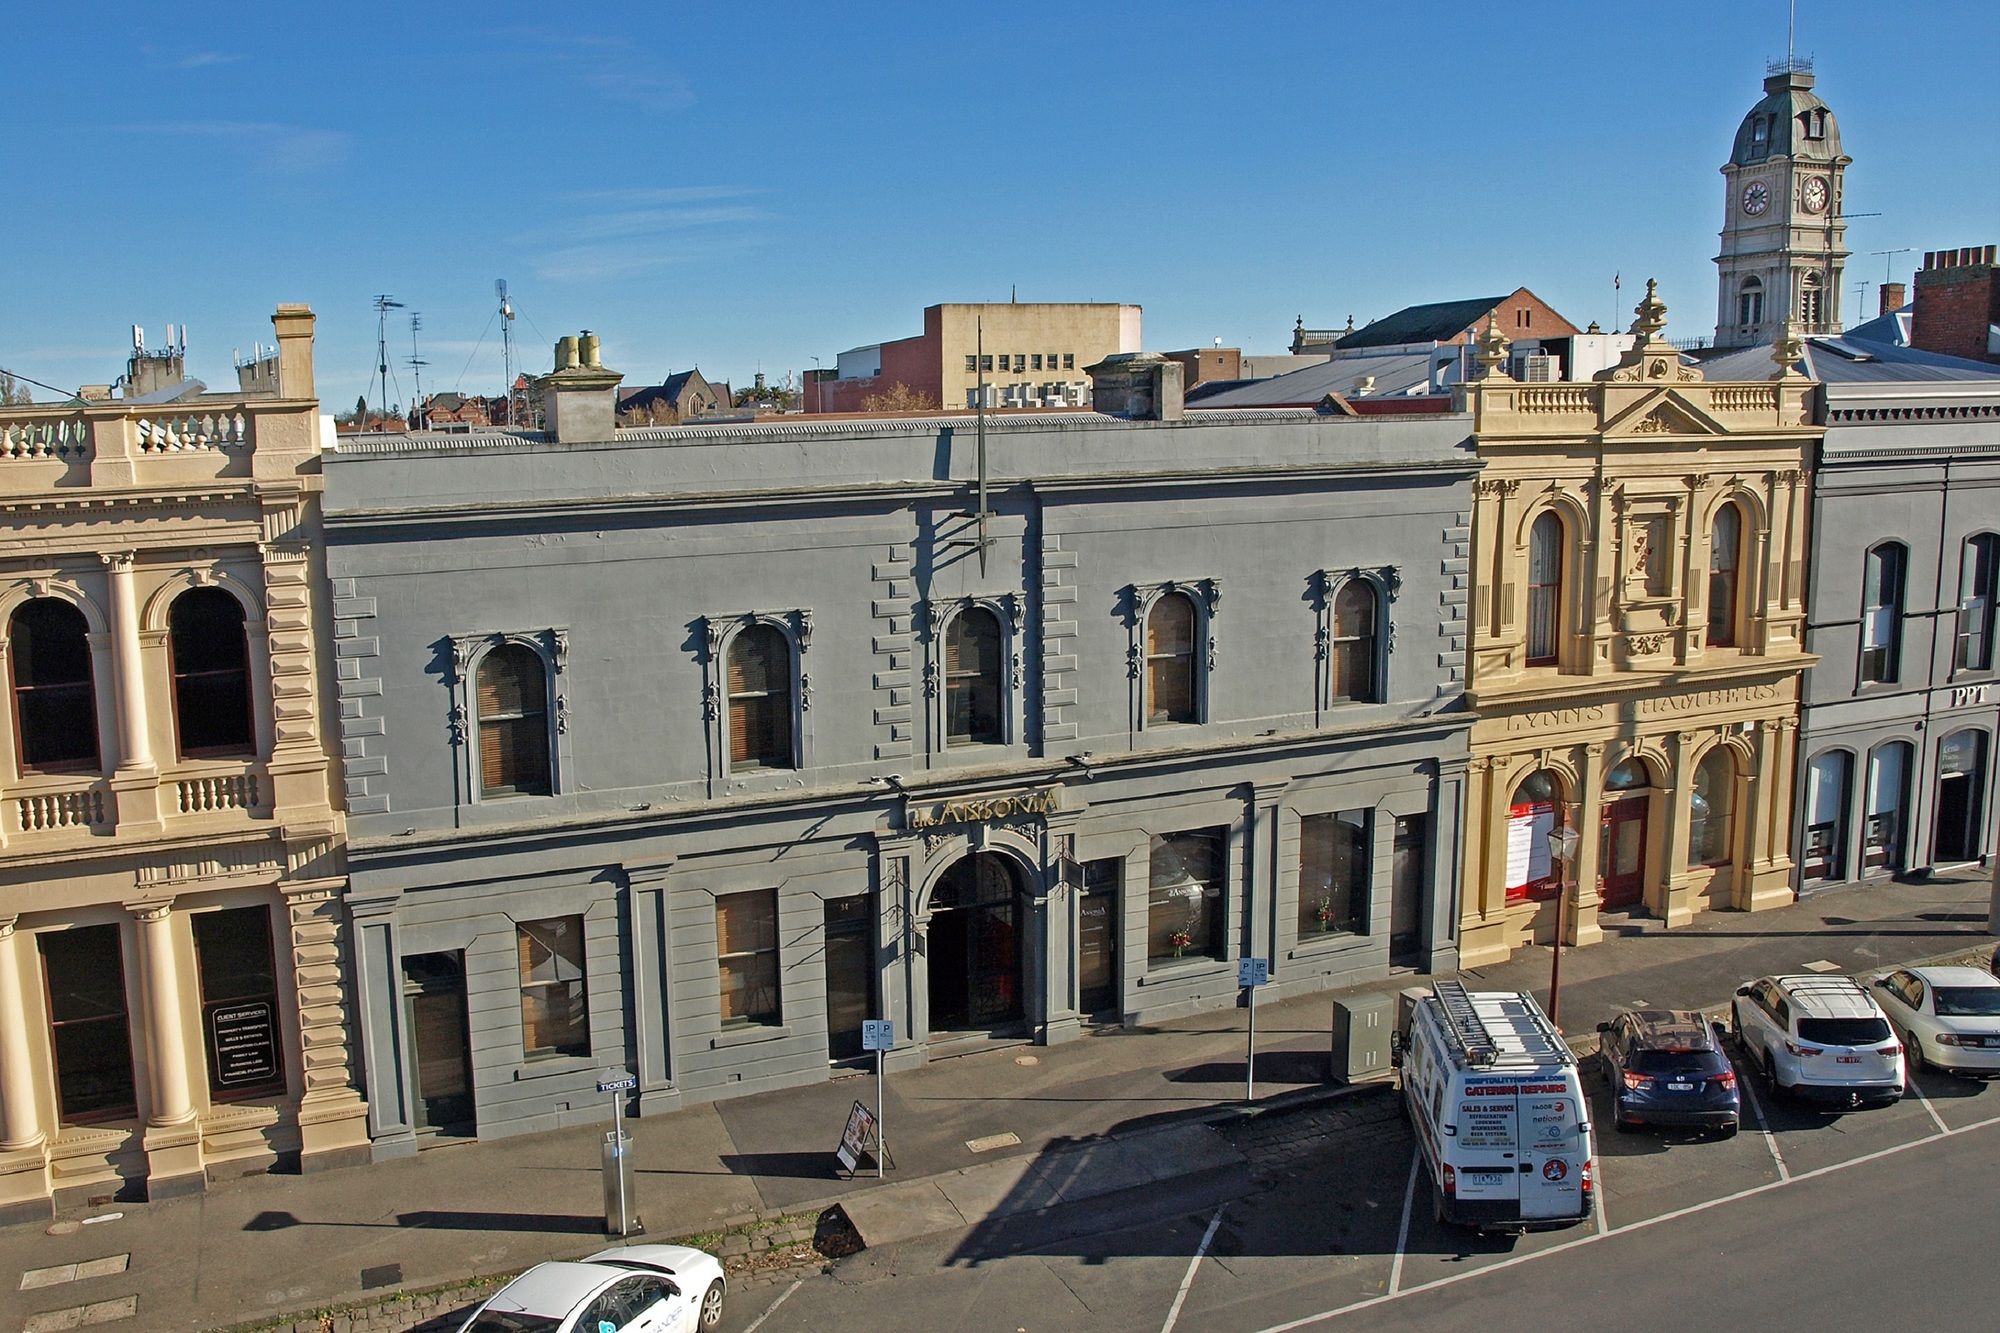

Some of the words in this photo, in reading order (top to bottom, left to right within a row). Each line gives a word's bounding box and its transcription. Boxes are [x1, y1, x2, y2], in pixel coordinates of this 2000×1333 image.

[1953, 684, 1990, 706] PPT
[1506, 704, 1605, 731] LYNN'S
[912, 807, 937, 828] the
[938, 791, 1059, 825] ANSONIA
[237, 1009, 267, 1017] SERVICES
[865, 1024, 876, 1032] 1P
[883, 1024, 890, 1033] P
[601, 1080, 634, 1091] TICKETS
[1465, 1086, 1519, 1096] CATERING
[1520, 1084, 1566, 1094] REPAIRS
[1489, 1104, 1514, 1112] SERVICE
[1533, 1114, 1565, 1122] national
